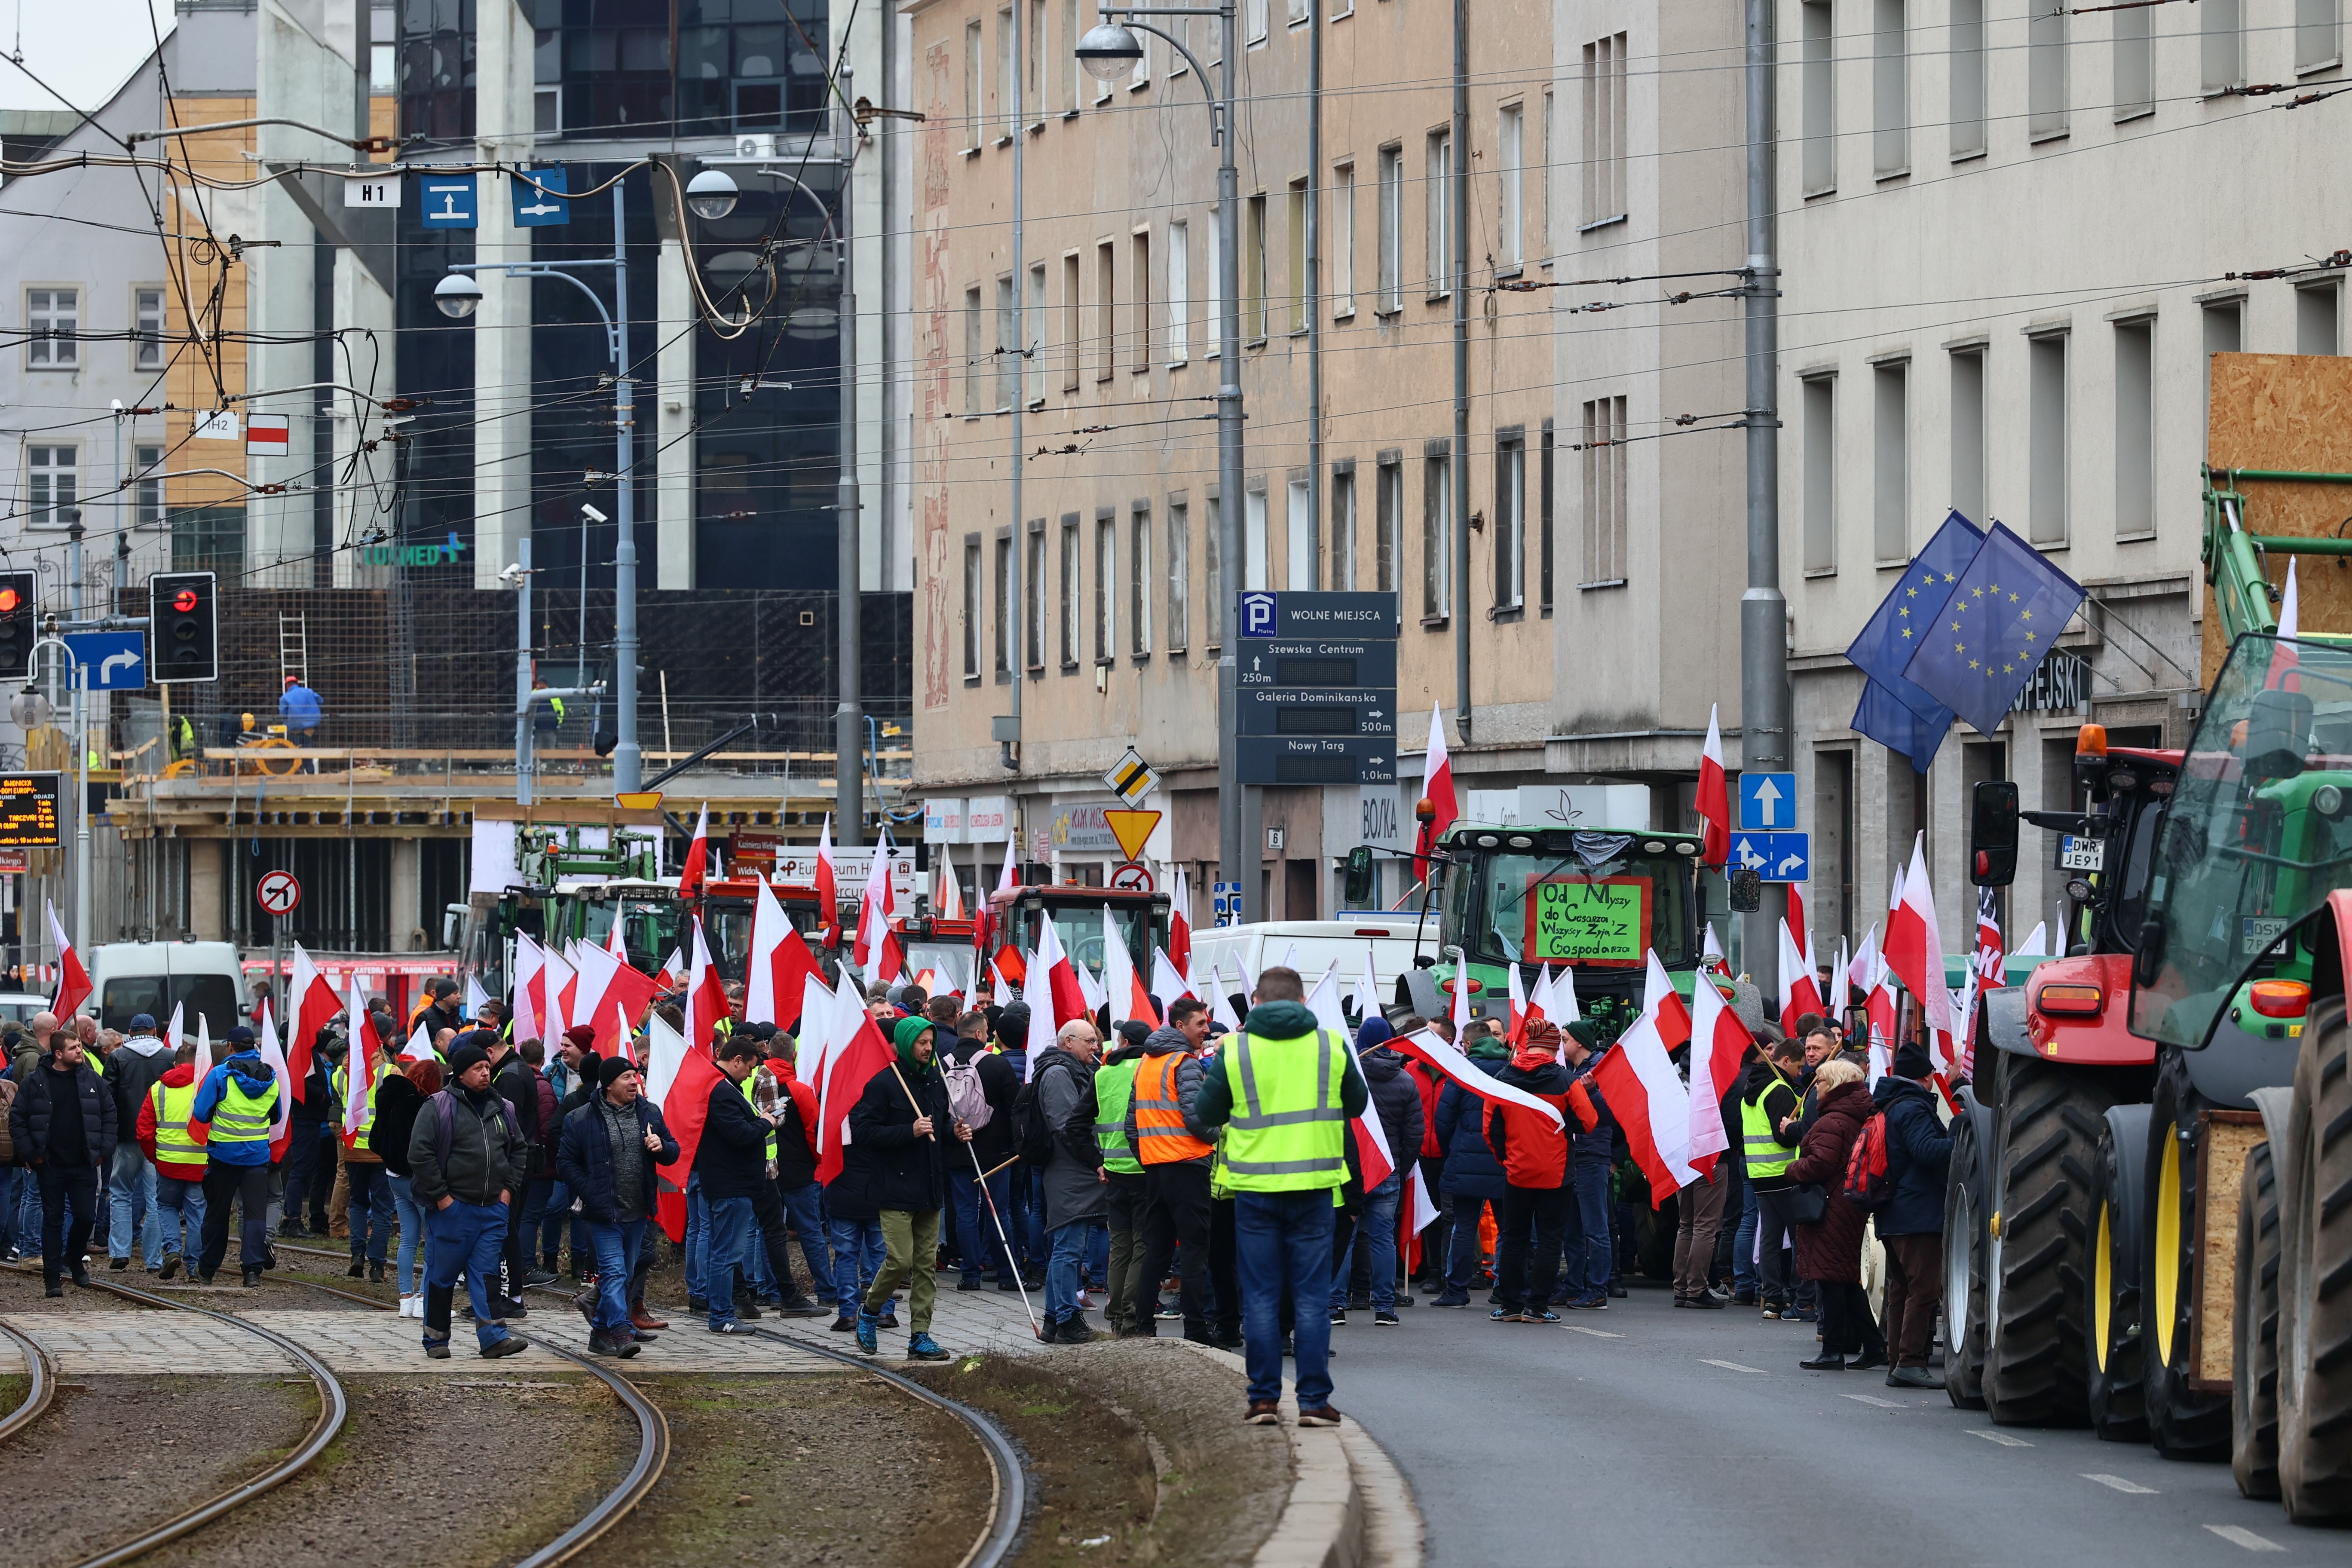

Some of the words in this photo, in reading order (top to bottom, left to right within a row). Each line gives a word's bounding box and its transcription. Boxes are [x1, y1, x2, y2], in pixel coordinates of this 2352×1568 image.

[1250, 603, 1270, 631] P
[1291, 610, 1330, 620] WOLNE
[1334, 611, 1381, 620] MIEJSCA
[1268, 644, 1312, 654] Szewska
[1319, 645, 1364, 654] Centrum
[1242, 673, 1271, 683] 250m
[2009, 655, 2081, 711] PEJSKI
[1256, 692, 1296, 701] Galeria
[1301, 692, 1377, 702] Dominikanska
[1361, 722, 1391, 732] 500m
[1289, 741, 1317, 753] Nowy
[1321, 741, 1344, 752] Targ
[1361, 771, 1392, 781] 1,0km
[1273, 833, 1278, 844] 6
[2073, 840, 2096, 853] DWR
[2066, 854, 2098, 867] JE91
[799, 862, 857, 875] Eureum
[1544, 884, 1567, 903] Od
[1583, 884, 1631, 910] Myszy
[1544, 906, 1559, 921] do
[1585, 922, 1611, 940] Żyją
[1613, 924, 1629, 935] Z
[1550, 935, 1630, 959] Gospodarza
[722, 1323, 735, 1333] N
